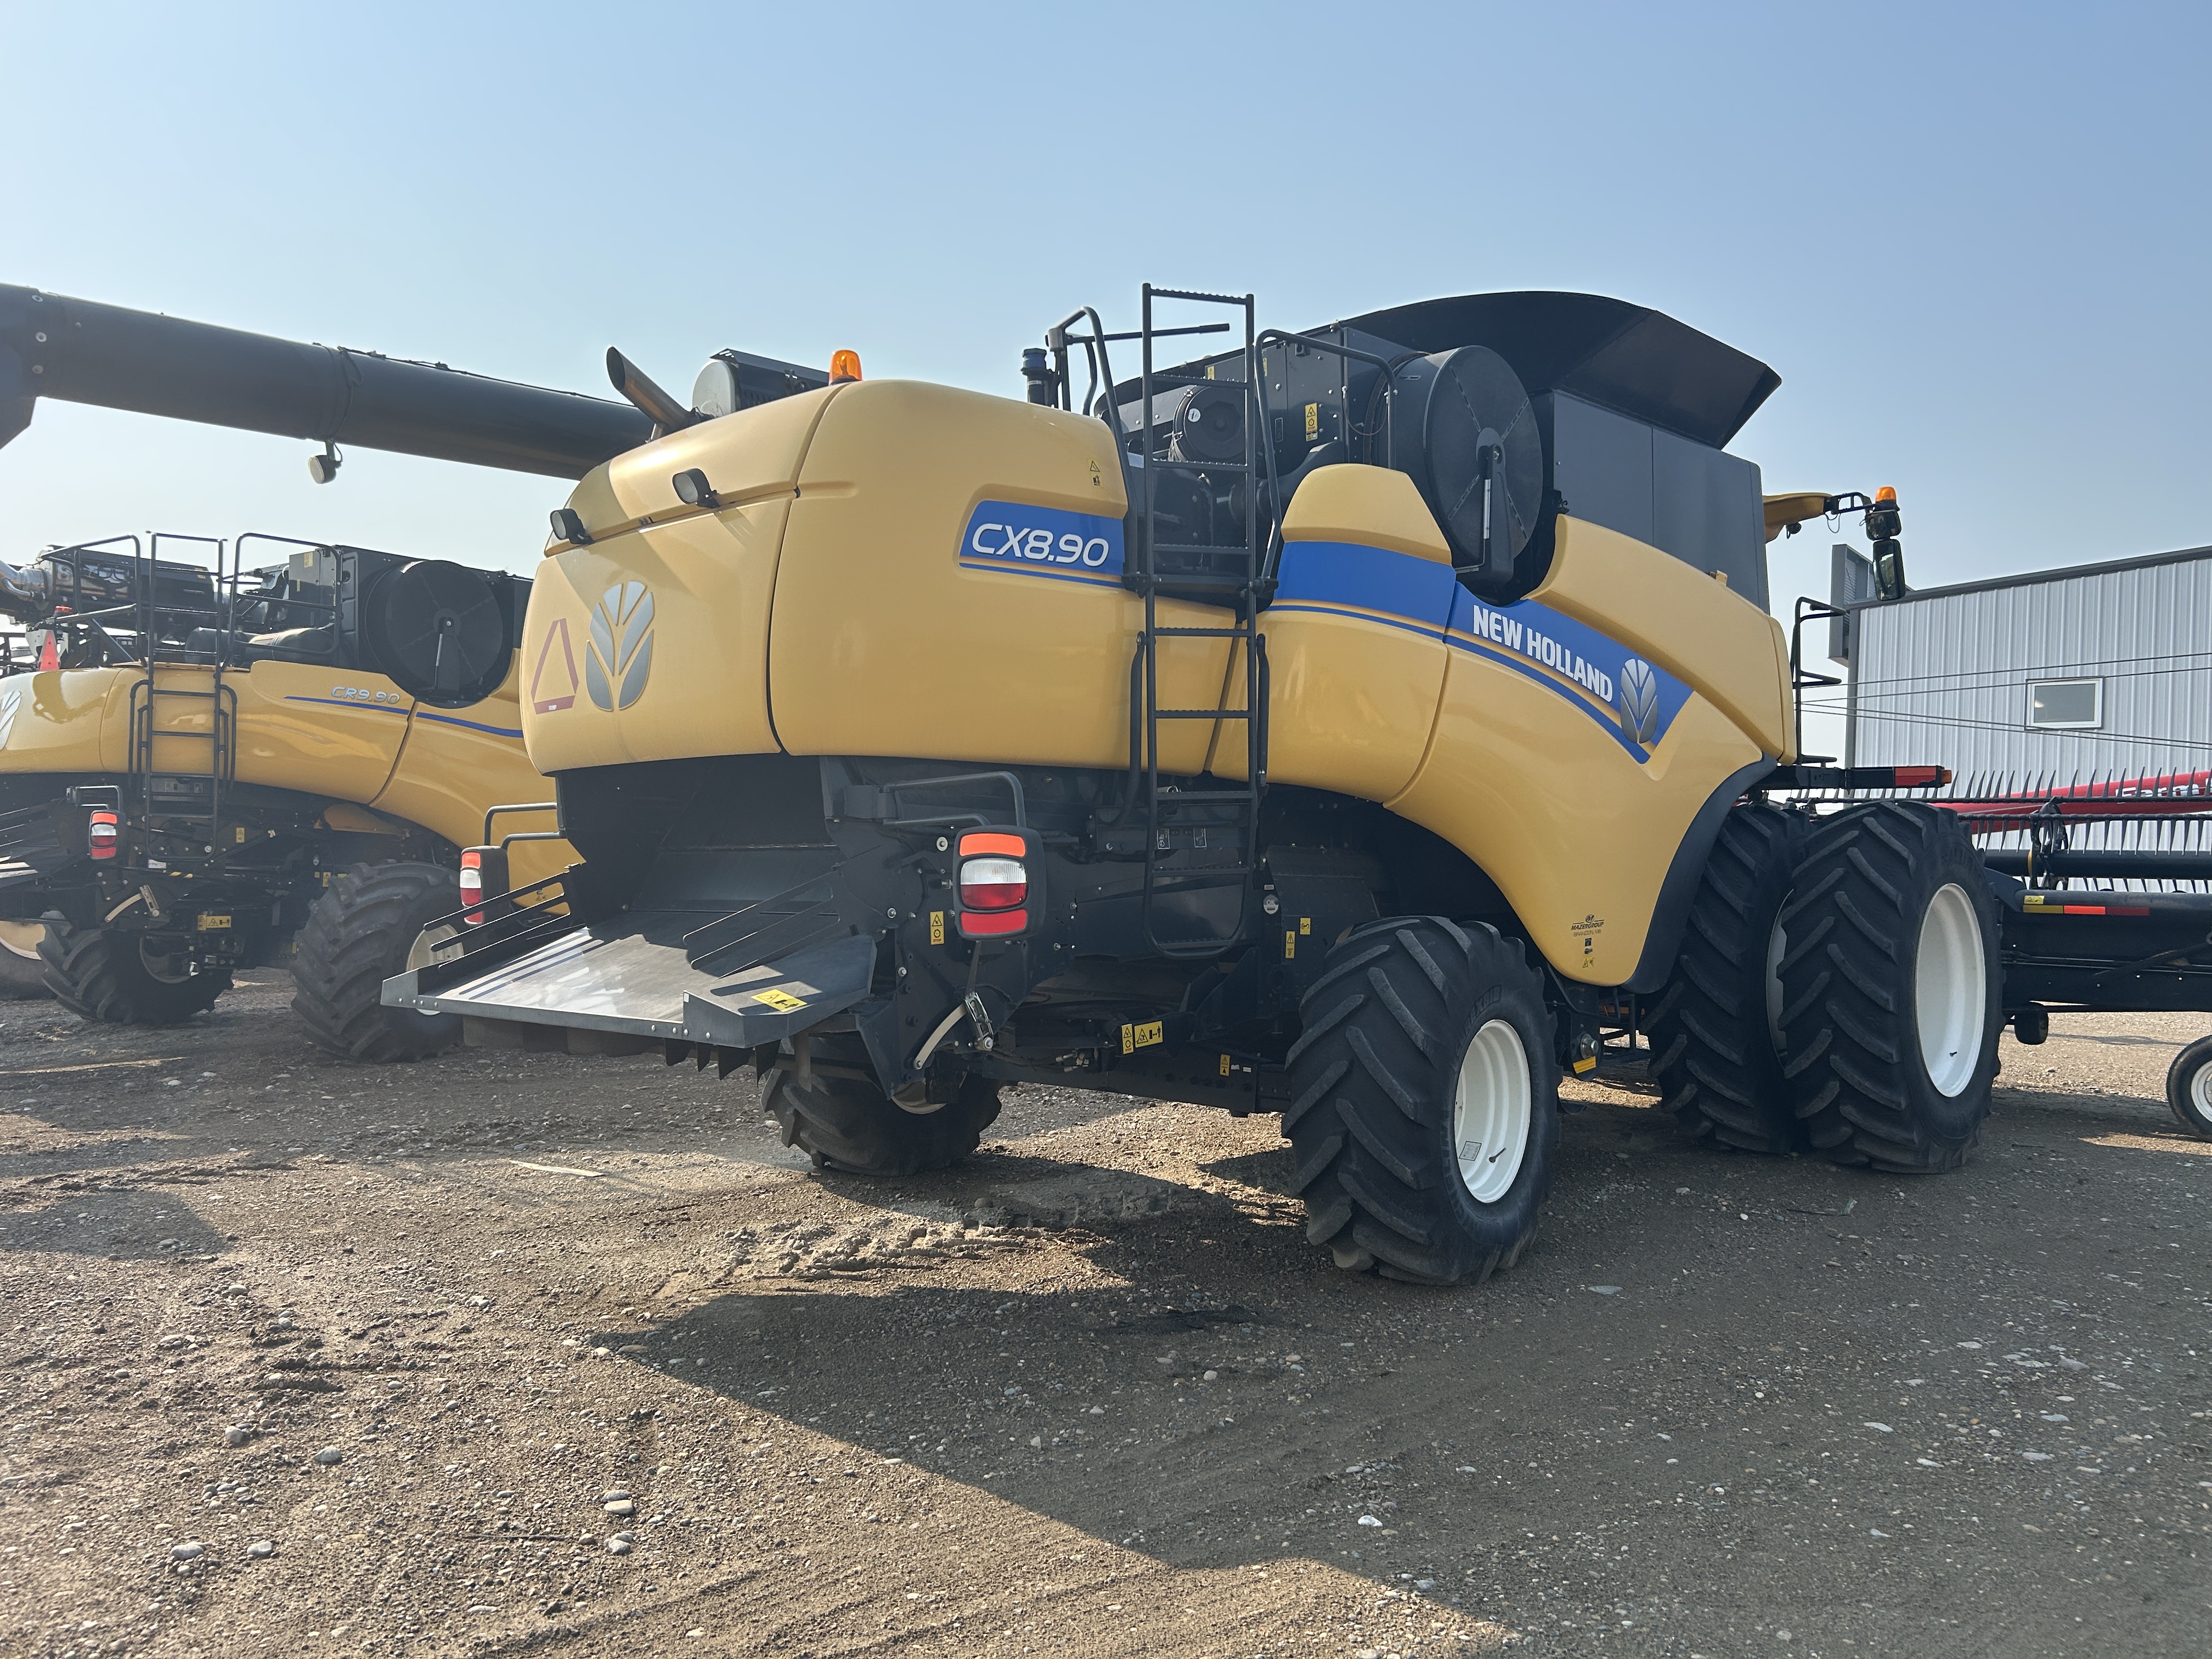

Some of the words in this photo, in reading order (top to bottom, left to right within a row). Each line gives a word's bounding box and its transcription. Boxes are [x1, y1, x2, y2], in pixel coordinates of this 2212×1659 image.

[972, 523, 1109, 567] CX8.90
[1473, 605, 1522, 651] NEW
[1527, 627, 1614, 703] HOLLAND
[331, 686, 400, 704] CR9.90
[1571, 922, 1605, 931] MAZERGROUP
